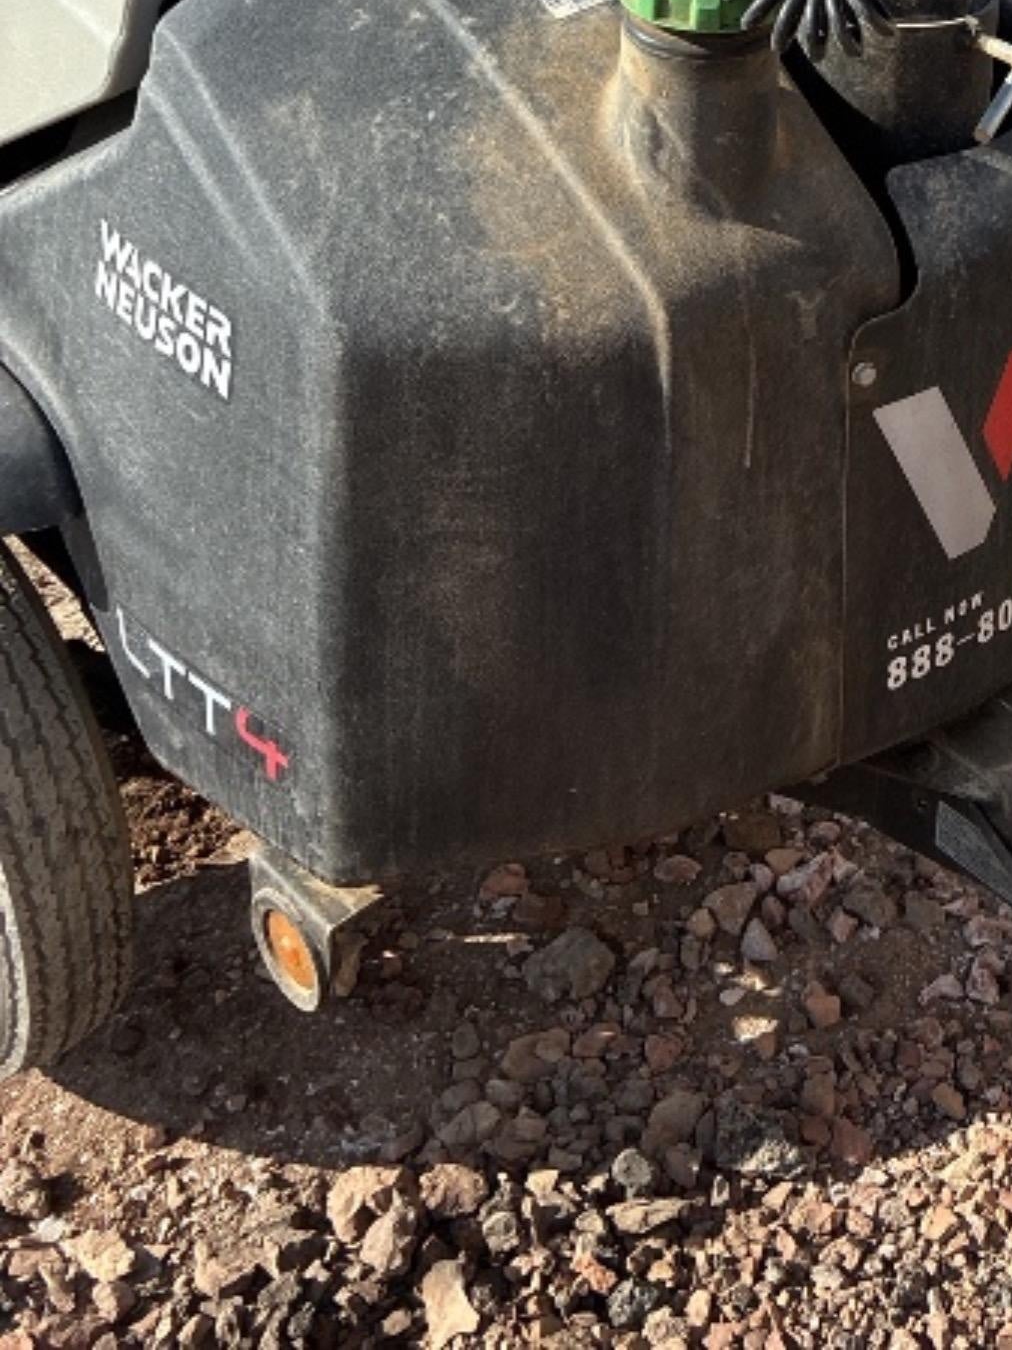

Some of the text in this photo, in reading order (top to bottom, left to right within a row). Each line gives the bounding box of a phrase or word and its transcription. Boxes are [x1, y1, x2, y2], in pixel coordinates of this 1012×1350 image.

[95, 259, 232, 400] NEUSON
[100, 217, 232, 358] WACKER
[887, 590, 984, 650] CALL NOW
[115, 602, 290, 781] LTT4
